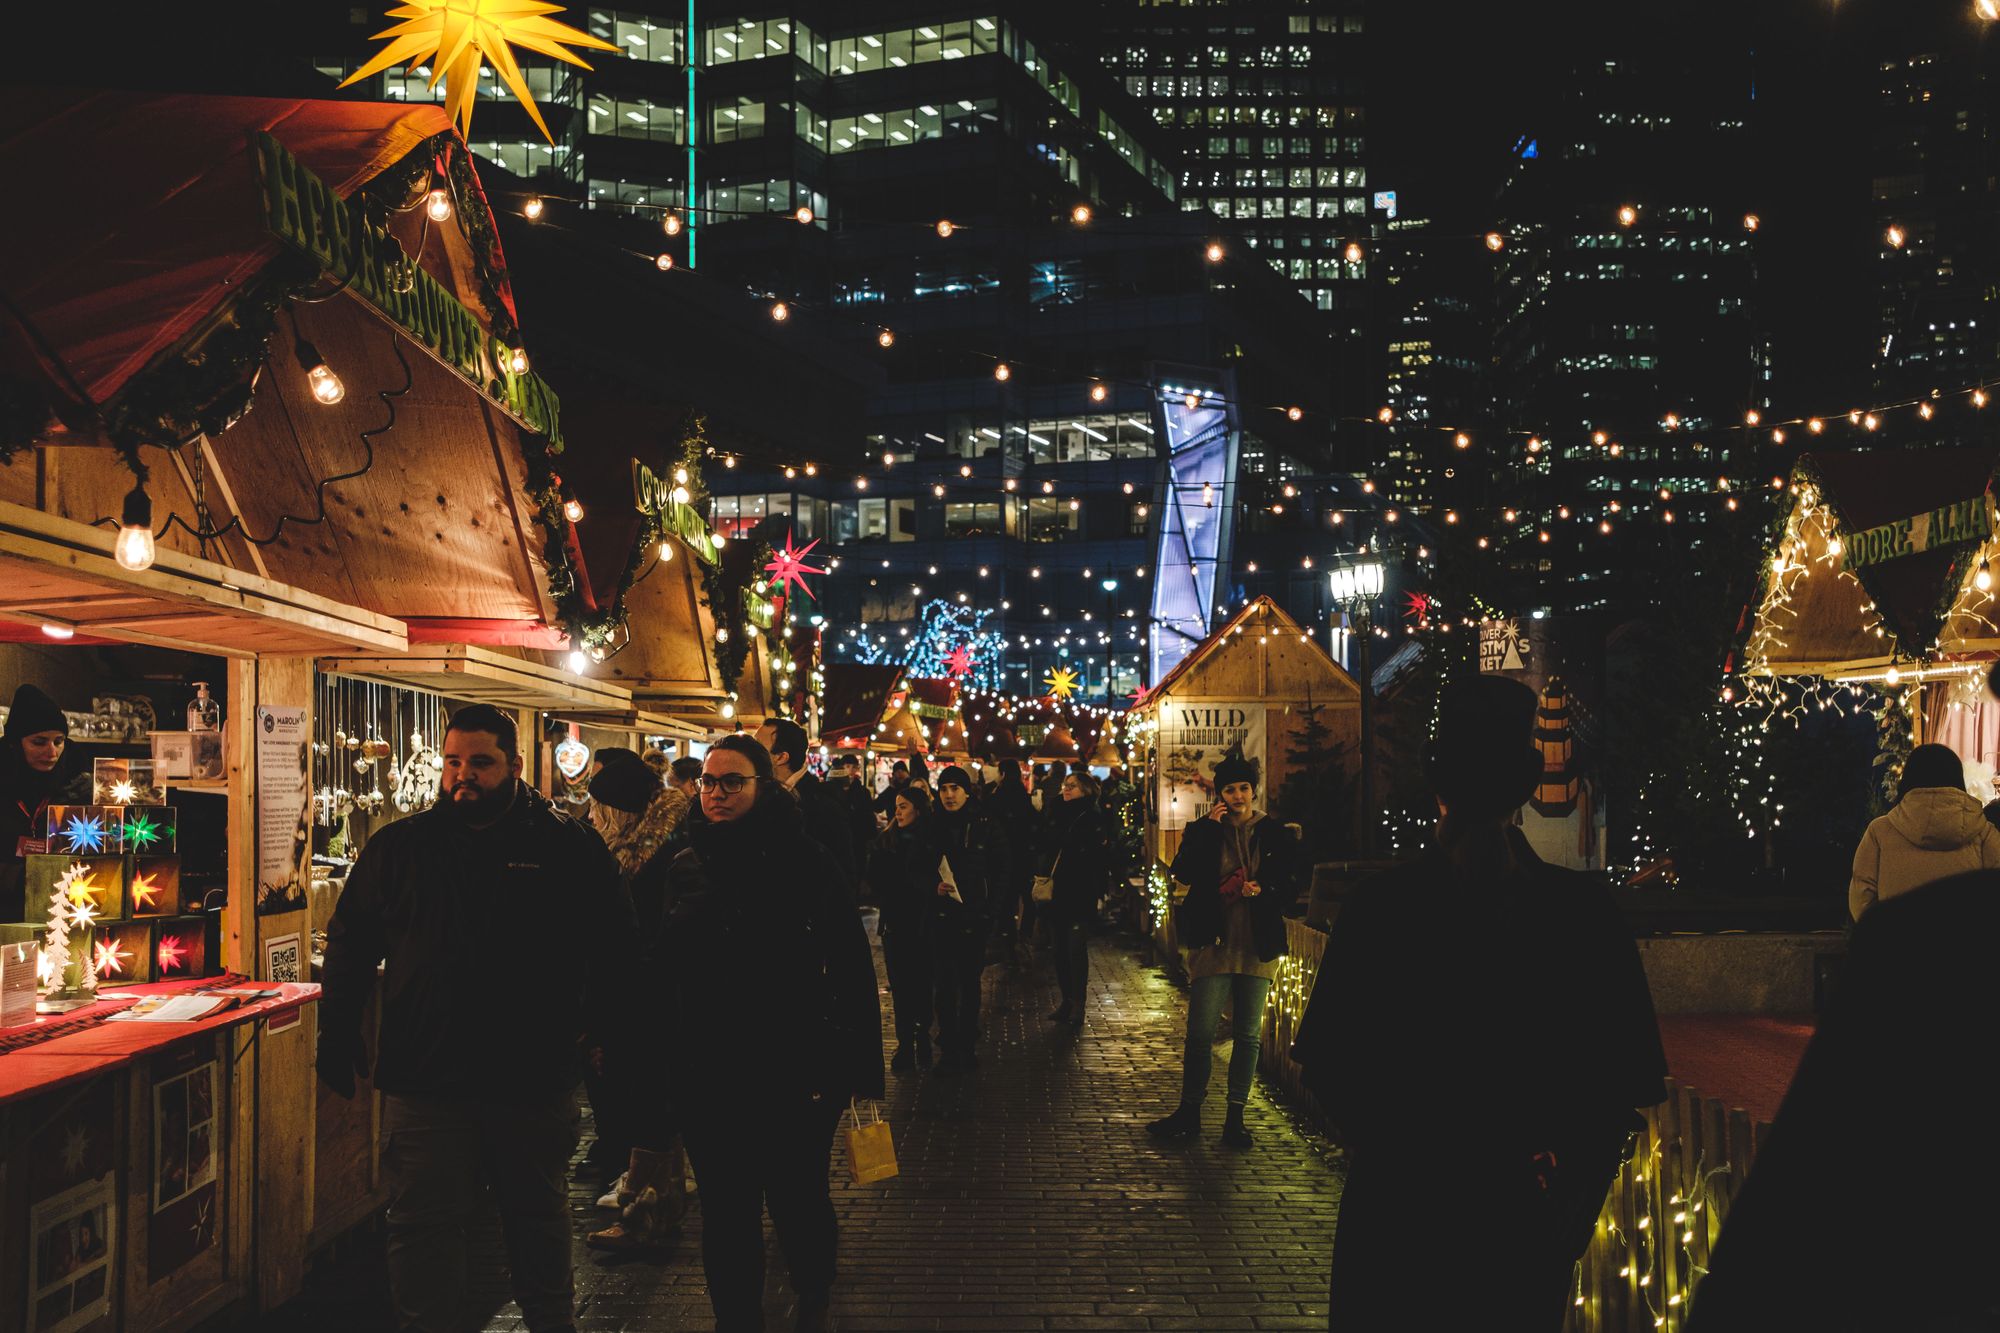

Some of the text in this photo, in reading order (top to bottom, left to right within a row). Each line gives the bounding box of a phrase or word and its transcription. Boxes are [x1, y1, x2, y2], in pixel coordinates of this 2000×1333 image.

[1842, 495, 1988, 570] ADORE ALMA
[1182, 709, 1245, 727] WILD
[1180, 728, 1248, 746] MUSHROOM SOUP
